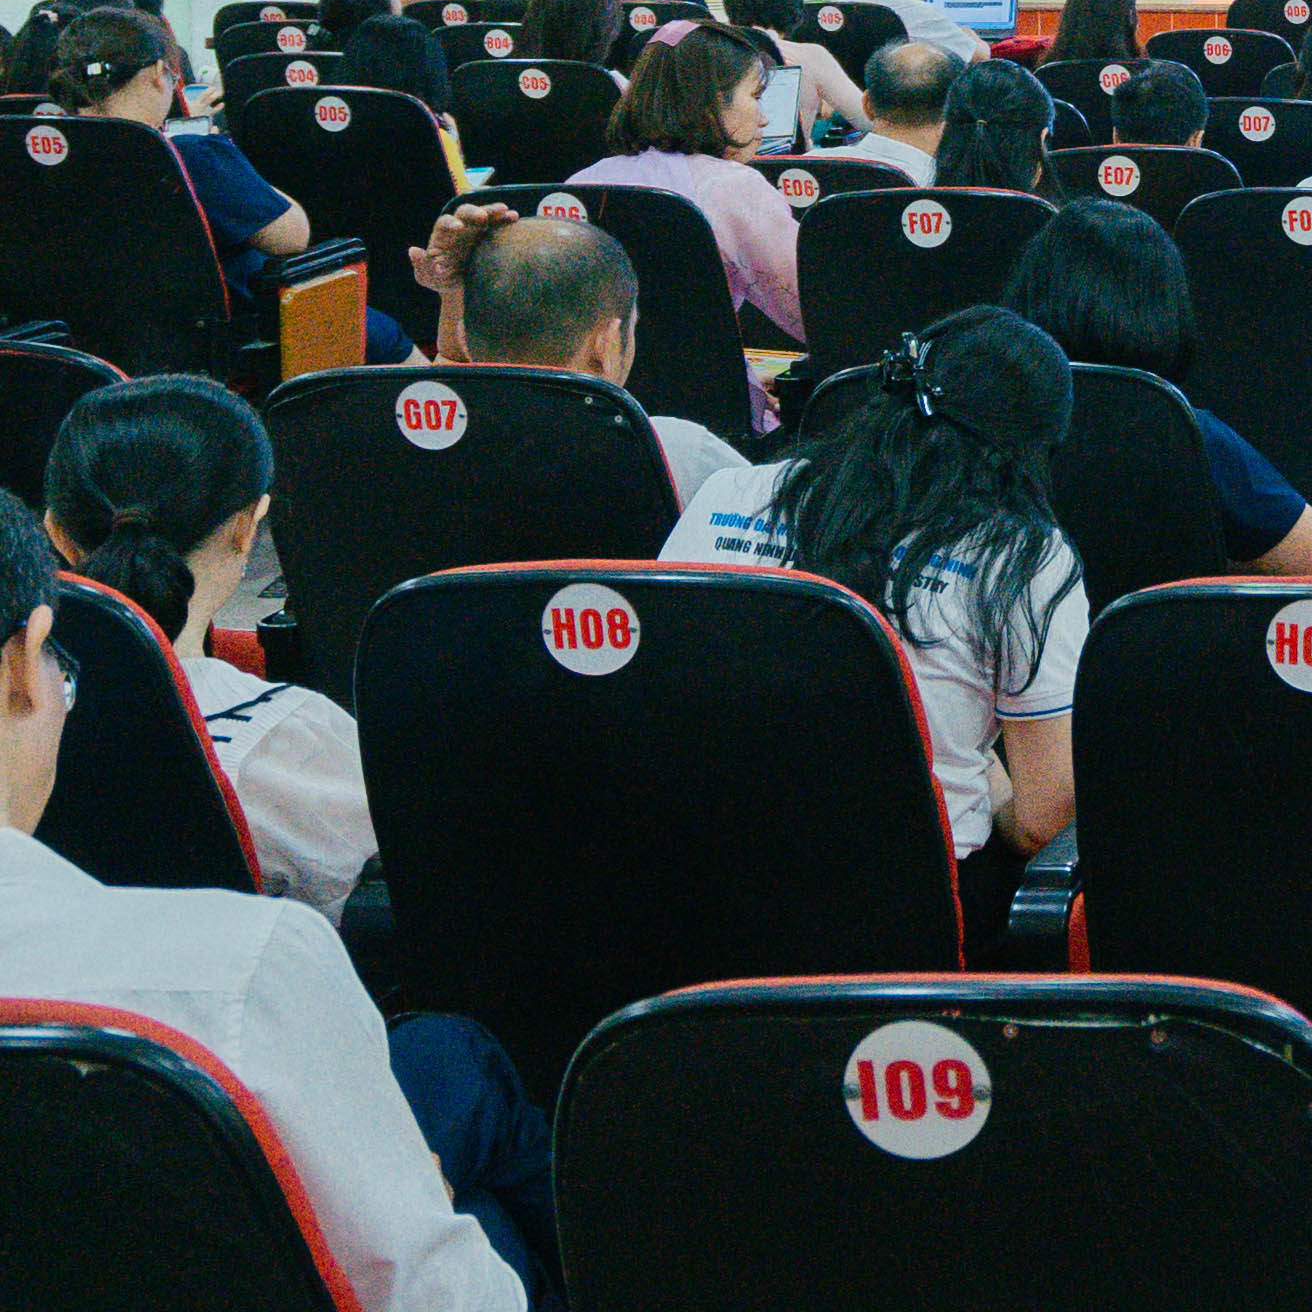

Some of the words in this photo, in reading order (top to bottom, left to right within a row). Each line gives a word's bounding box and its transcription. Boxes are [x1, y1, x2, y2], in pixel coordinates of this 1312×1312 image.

[486, 36, 511, 50] B04
[1205, 42, 1230, 57] B06
[288, 68, 315, 83] C04
[522, 75, 548, 91] C05
[319, 106, 347, 122] D05
[1242, 115, 1271, 132] D07
[31, 136, 63, 154] E05
[1104, 166, 1134, 185] E07
[782, 179, 814, 197] E06
[908, 212, 943, 234] F07
[403, 399, 457, 430] G07
[551, 608, 627, 649] H08
[858, 1059, 975, 1122] I09
